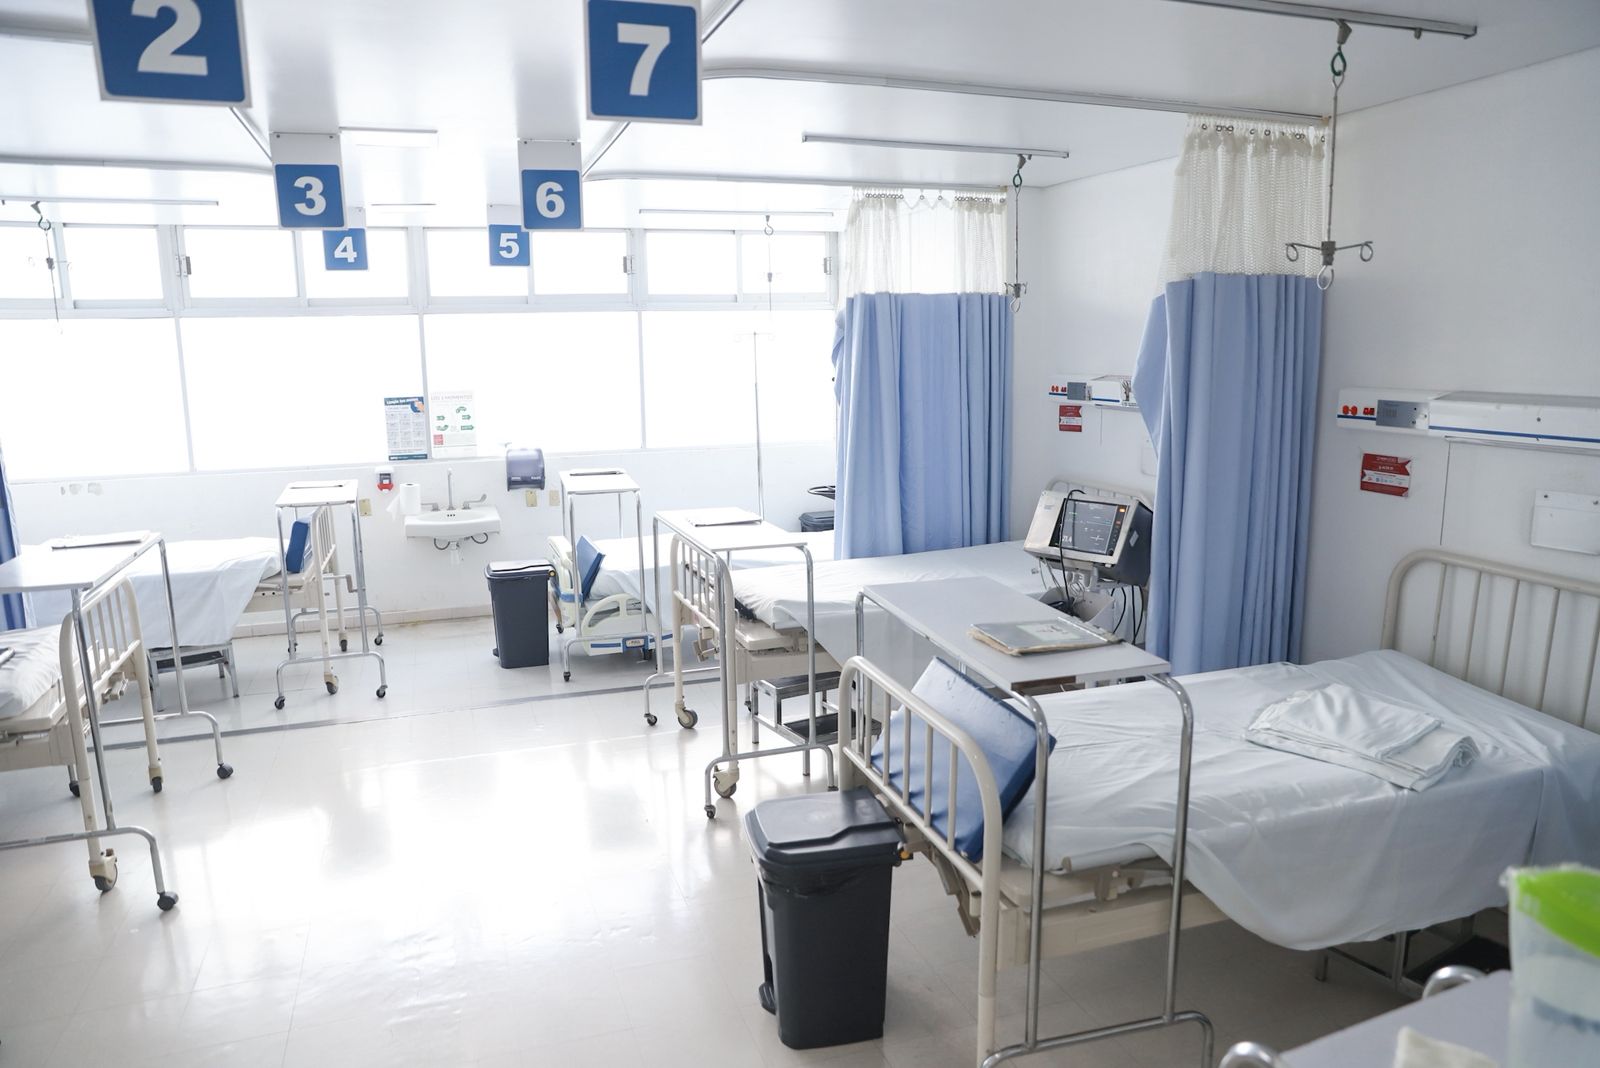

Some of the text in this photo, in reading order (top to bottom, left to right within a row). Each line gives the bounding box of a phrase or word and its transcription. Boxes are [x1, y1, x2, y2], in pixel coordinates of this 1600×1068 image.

[132, 0, 208, 76] 2
[617, 23, 671, 97] 7
[294, 176, 327, 216] 3
[536, 182, 566, 219] 6
[334, 236, 358, 263] 4
[499, 233, 520, 259] 5
